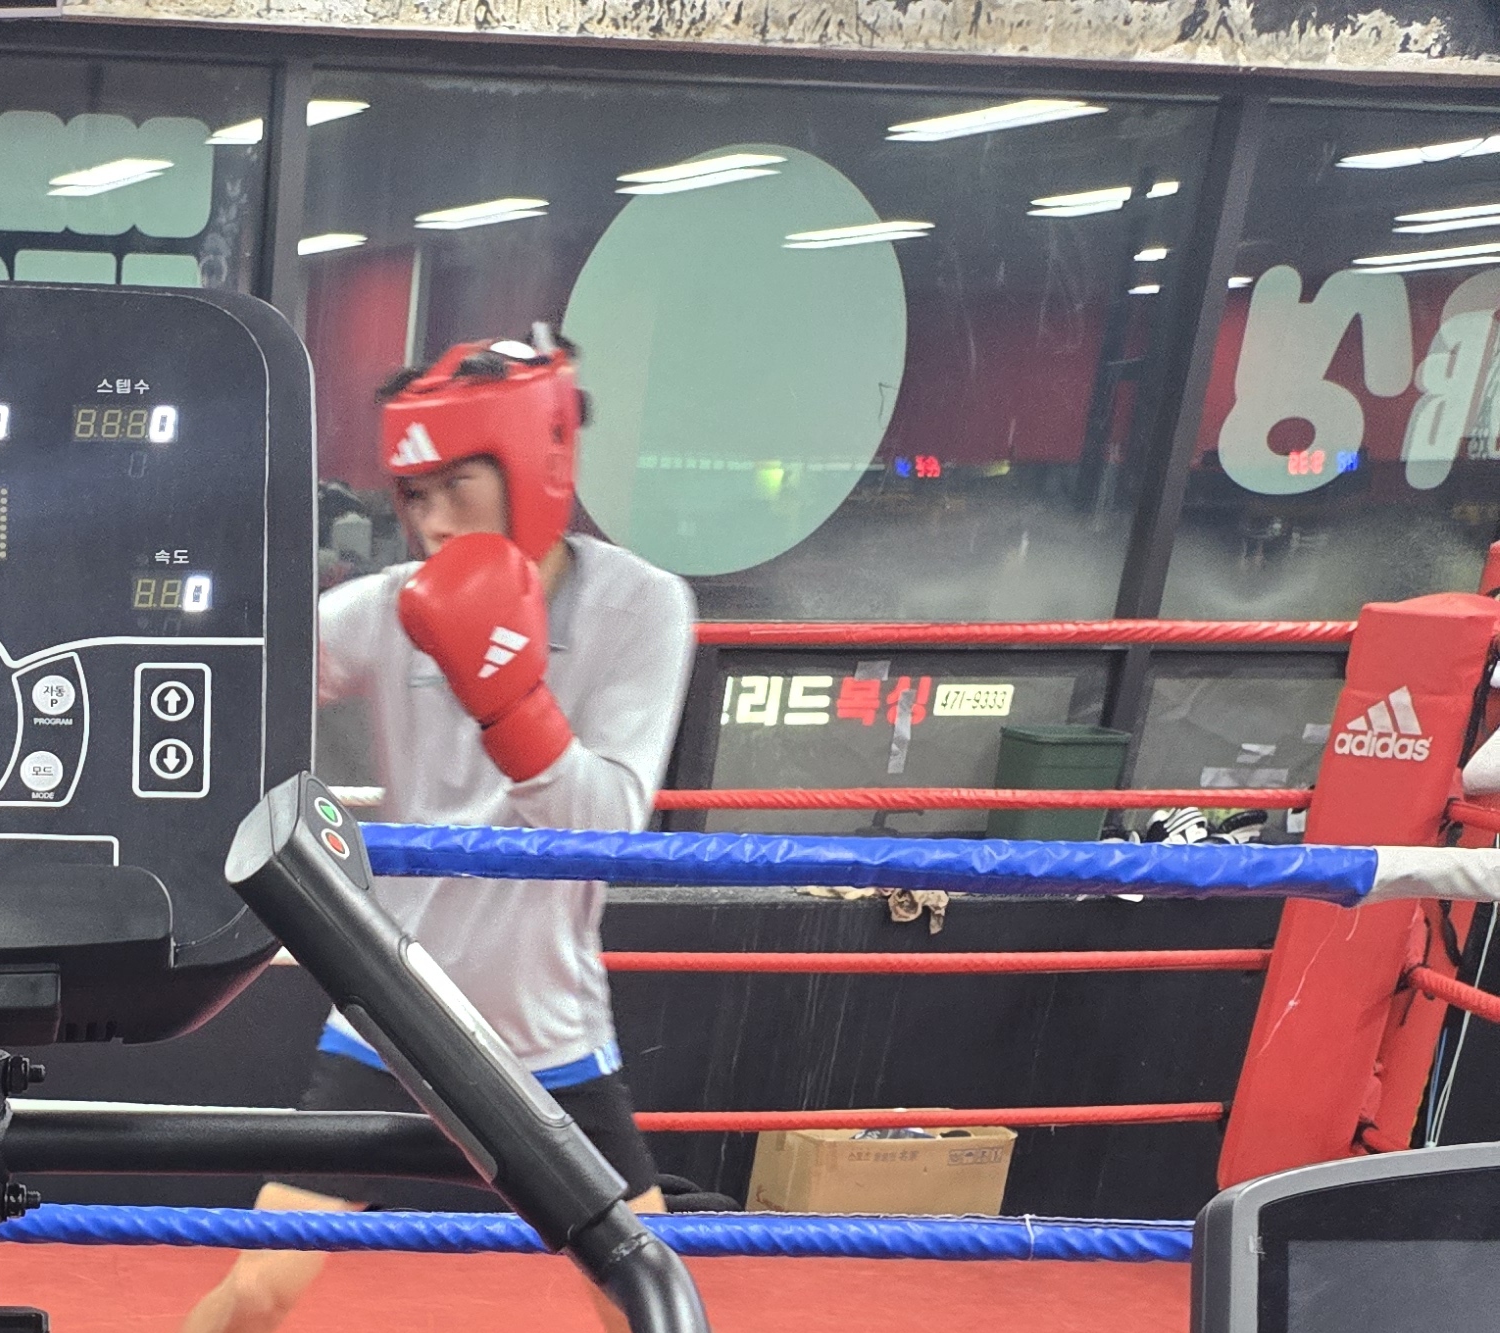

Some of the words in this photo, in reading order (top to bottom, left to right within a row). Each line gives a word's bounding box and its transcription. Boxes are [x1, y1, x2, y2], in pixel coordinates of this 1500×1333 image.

[96, 378, 150, 395] 스텝수
[154, 549, 190, 565] 속도
[43, 685, 66, 697] 자동
[50, 699, 59, 708] P
[33, 717, 74, 726] PROGRAM
[1334, 729, 1431, 763] adidas
[31, 766, 54, 777] 모드
[31, 791, 55, 800] MODE
